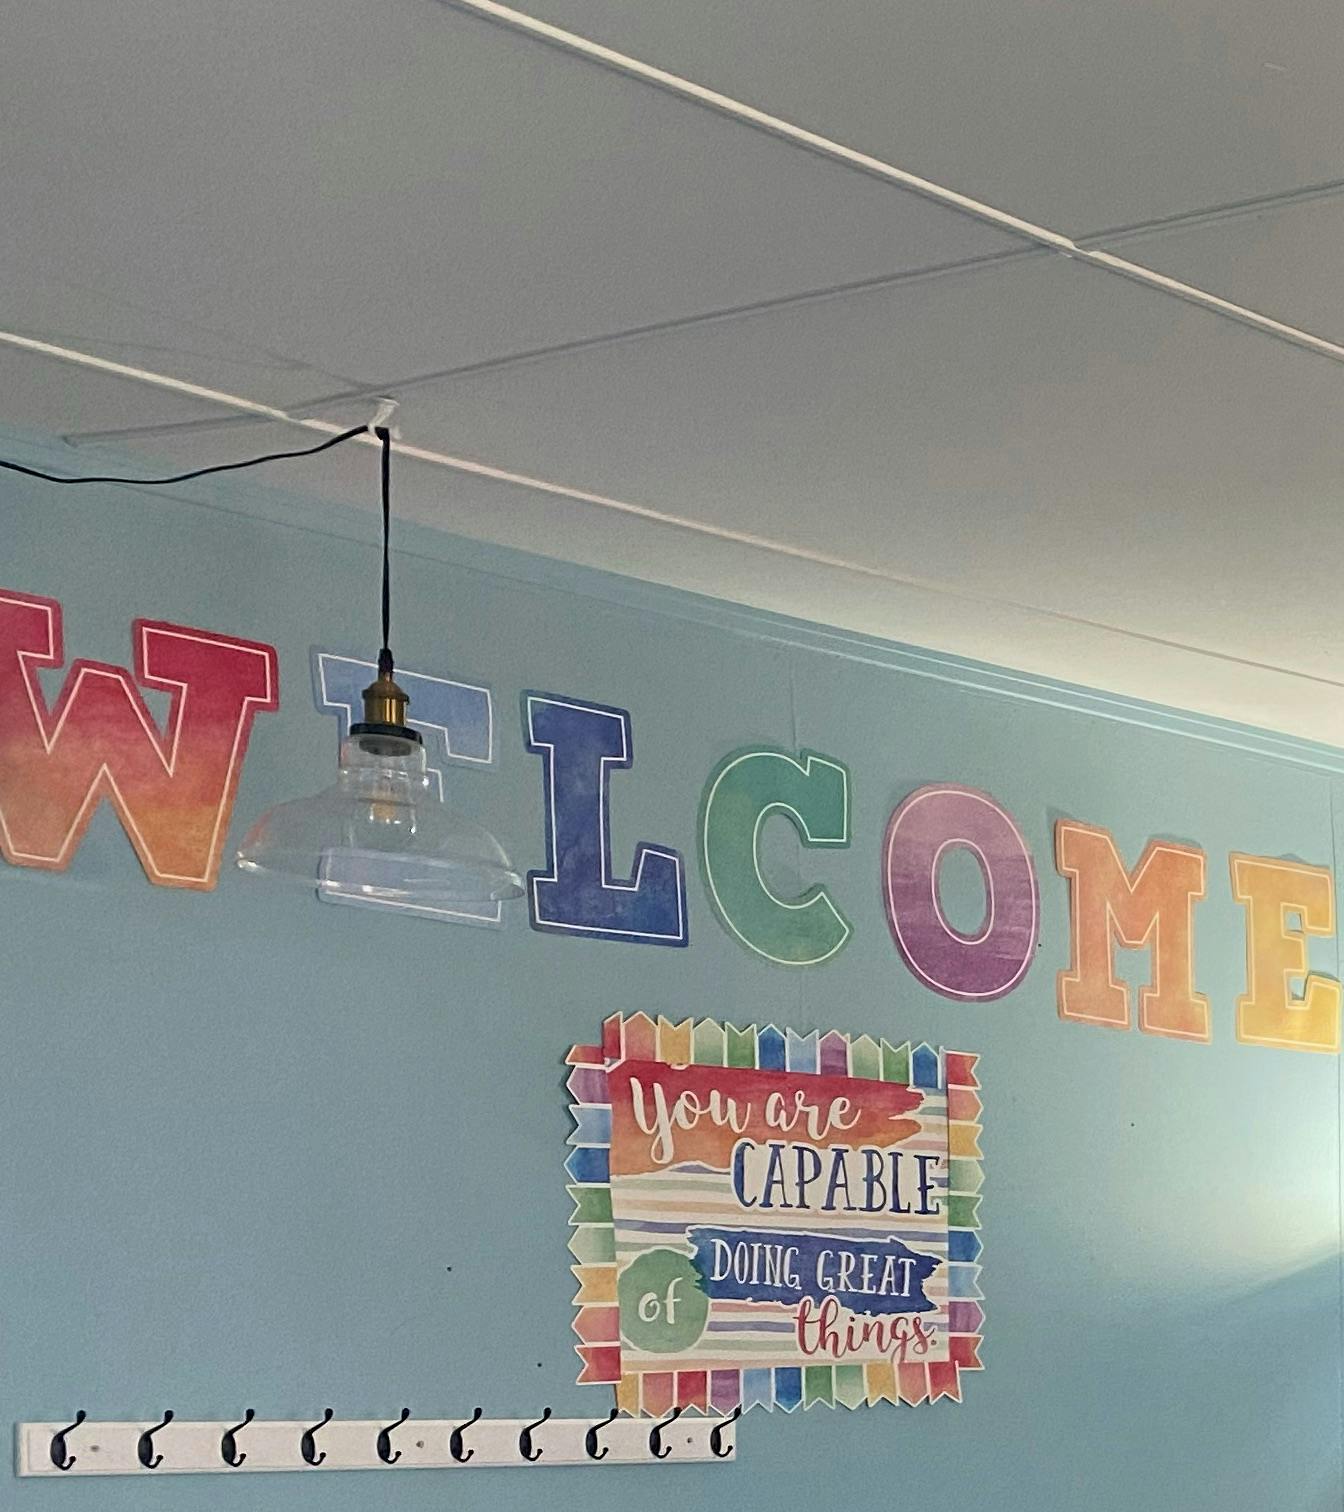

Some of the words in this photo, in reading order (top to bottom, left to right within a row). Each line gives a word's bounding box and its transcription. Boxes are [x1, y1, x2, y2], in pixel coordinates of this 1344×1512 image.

[0, 588, 1342, 1056] WELCOME
[629, 1076, 752, 1165] You
[765, 1090, 862, 1141] are
[734, 1141, 941, 1215] CAPABLE
[637, 1276, 683, 1325] of
[710, 1238, 802, 1291] DOING
[816, 1249, 918, 1298] GREAT
[793, 1294, 938, 1364] things.
